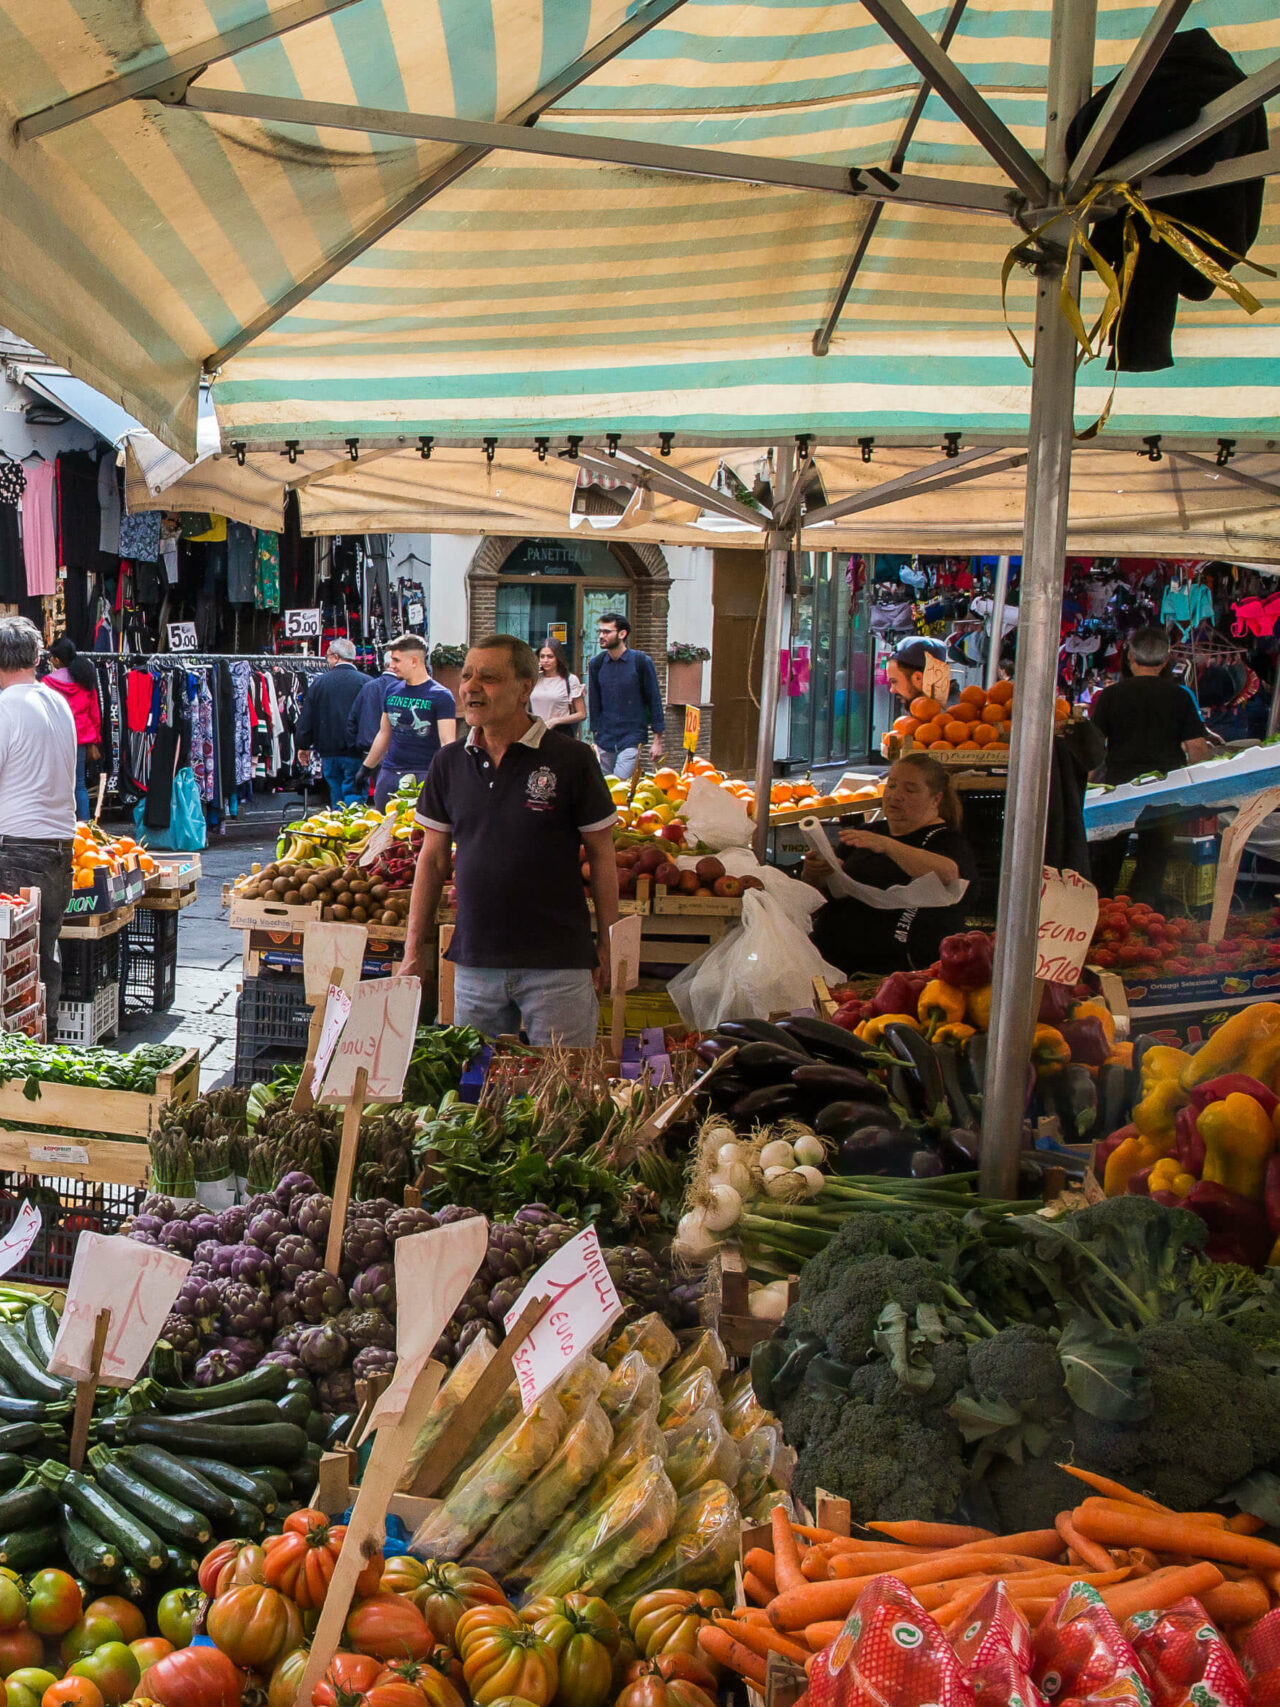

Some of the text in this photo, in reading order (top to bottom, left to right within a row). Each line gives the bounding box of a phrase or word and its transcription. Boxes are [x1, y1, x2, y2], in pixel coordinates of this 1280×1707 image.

[288, 612, 318, 635] 5,00
[782, 844, 810, 853] CCHIA
[64, 895, 99, 913] ION
[1150, 978, 1218, 990] Ortaggi Selezionati
